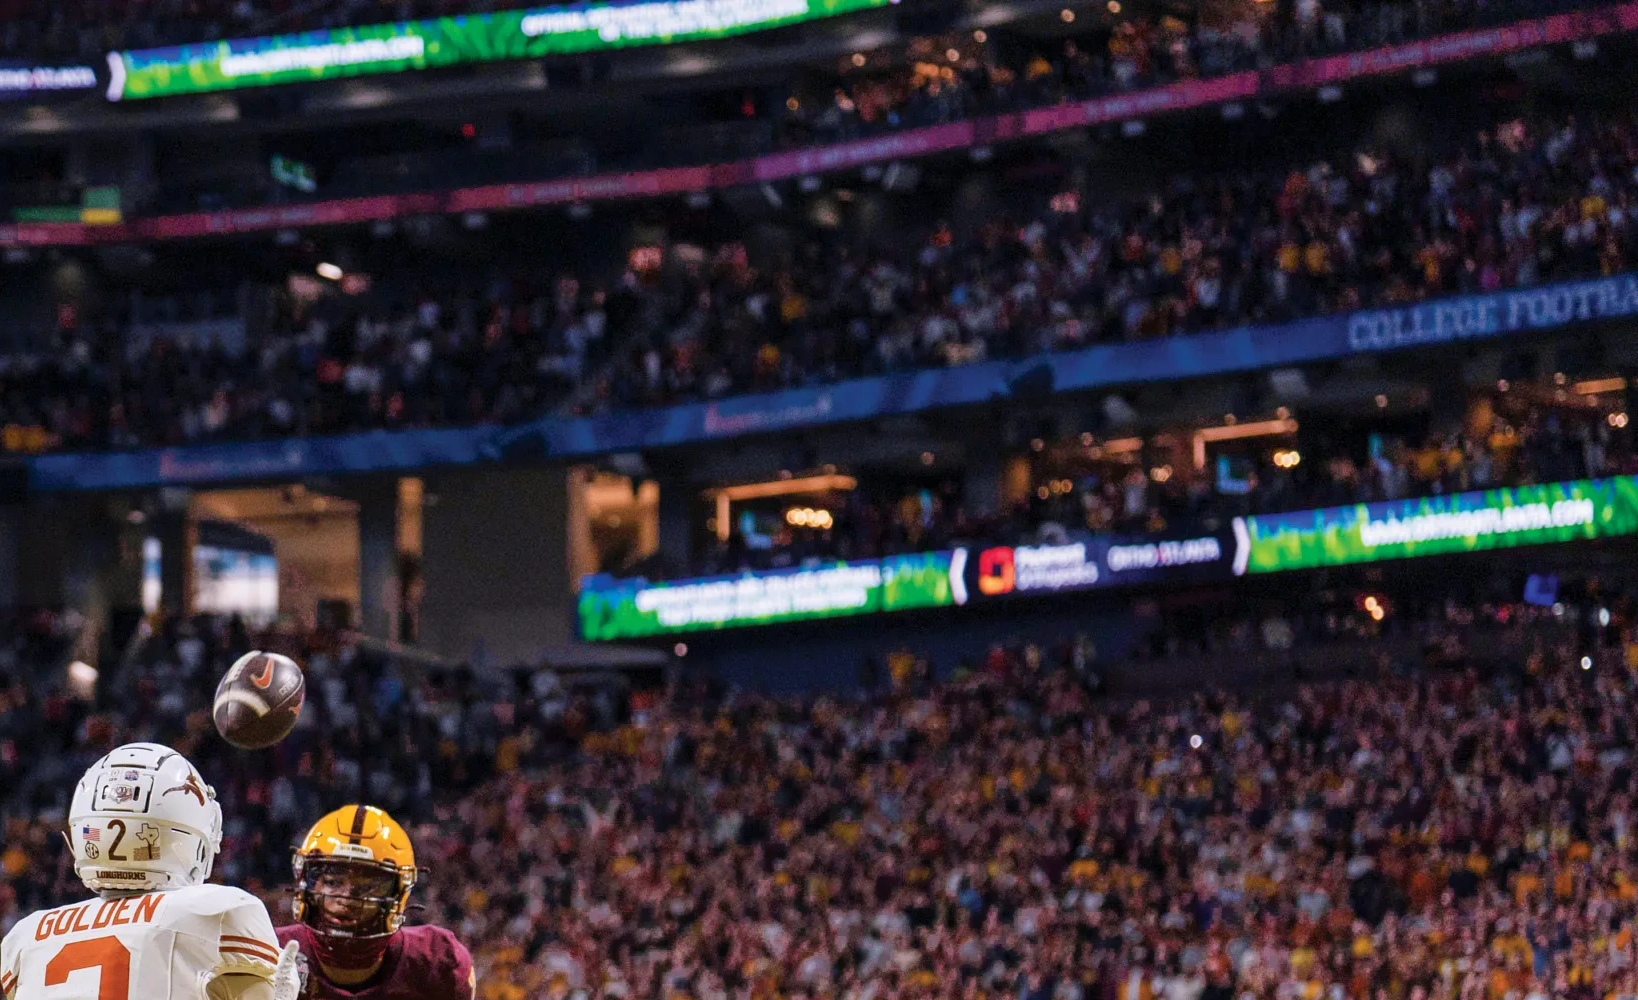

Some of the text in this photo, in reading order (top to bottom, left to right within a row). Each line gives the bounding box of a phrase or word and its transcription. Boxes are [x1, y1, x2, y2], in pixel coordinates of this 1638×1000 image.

[1348, 297, 1498, 350] COLLEGE
[107, 818, 128, 861] 2
[96, 870, 146, 880] LONGHORNS
[35, 894, 165, 942] GOLDEN
